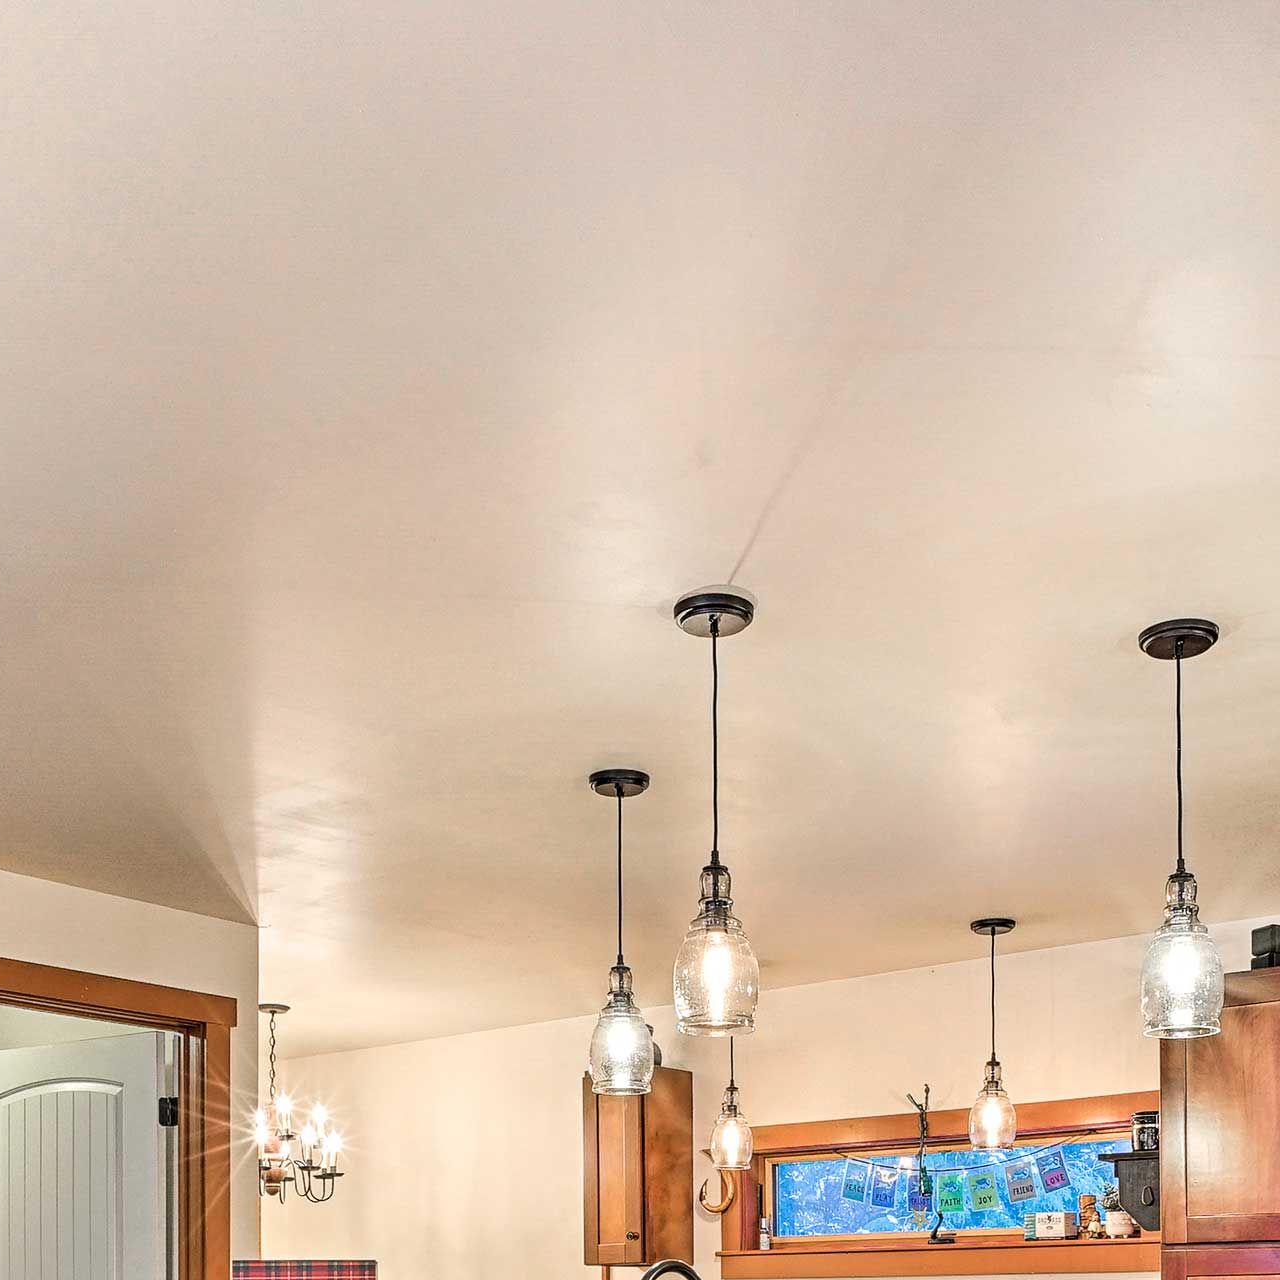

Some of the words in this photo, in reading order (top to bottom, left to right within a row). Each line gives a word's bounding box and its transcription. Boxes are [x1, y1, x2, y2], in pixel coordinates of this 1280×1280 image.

[1045, 1173, 1066, 1187] LOVE
[1012, 1184, 1034, 1196] FRIEND
[940, 1197, 961, 1208] FAITH
[978, 1195, 993, 1206] JOY
